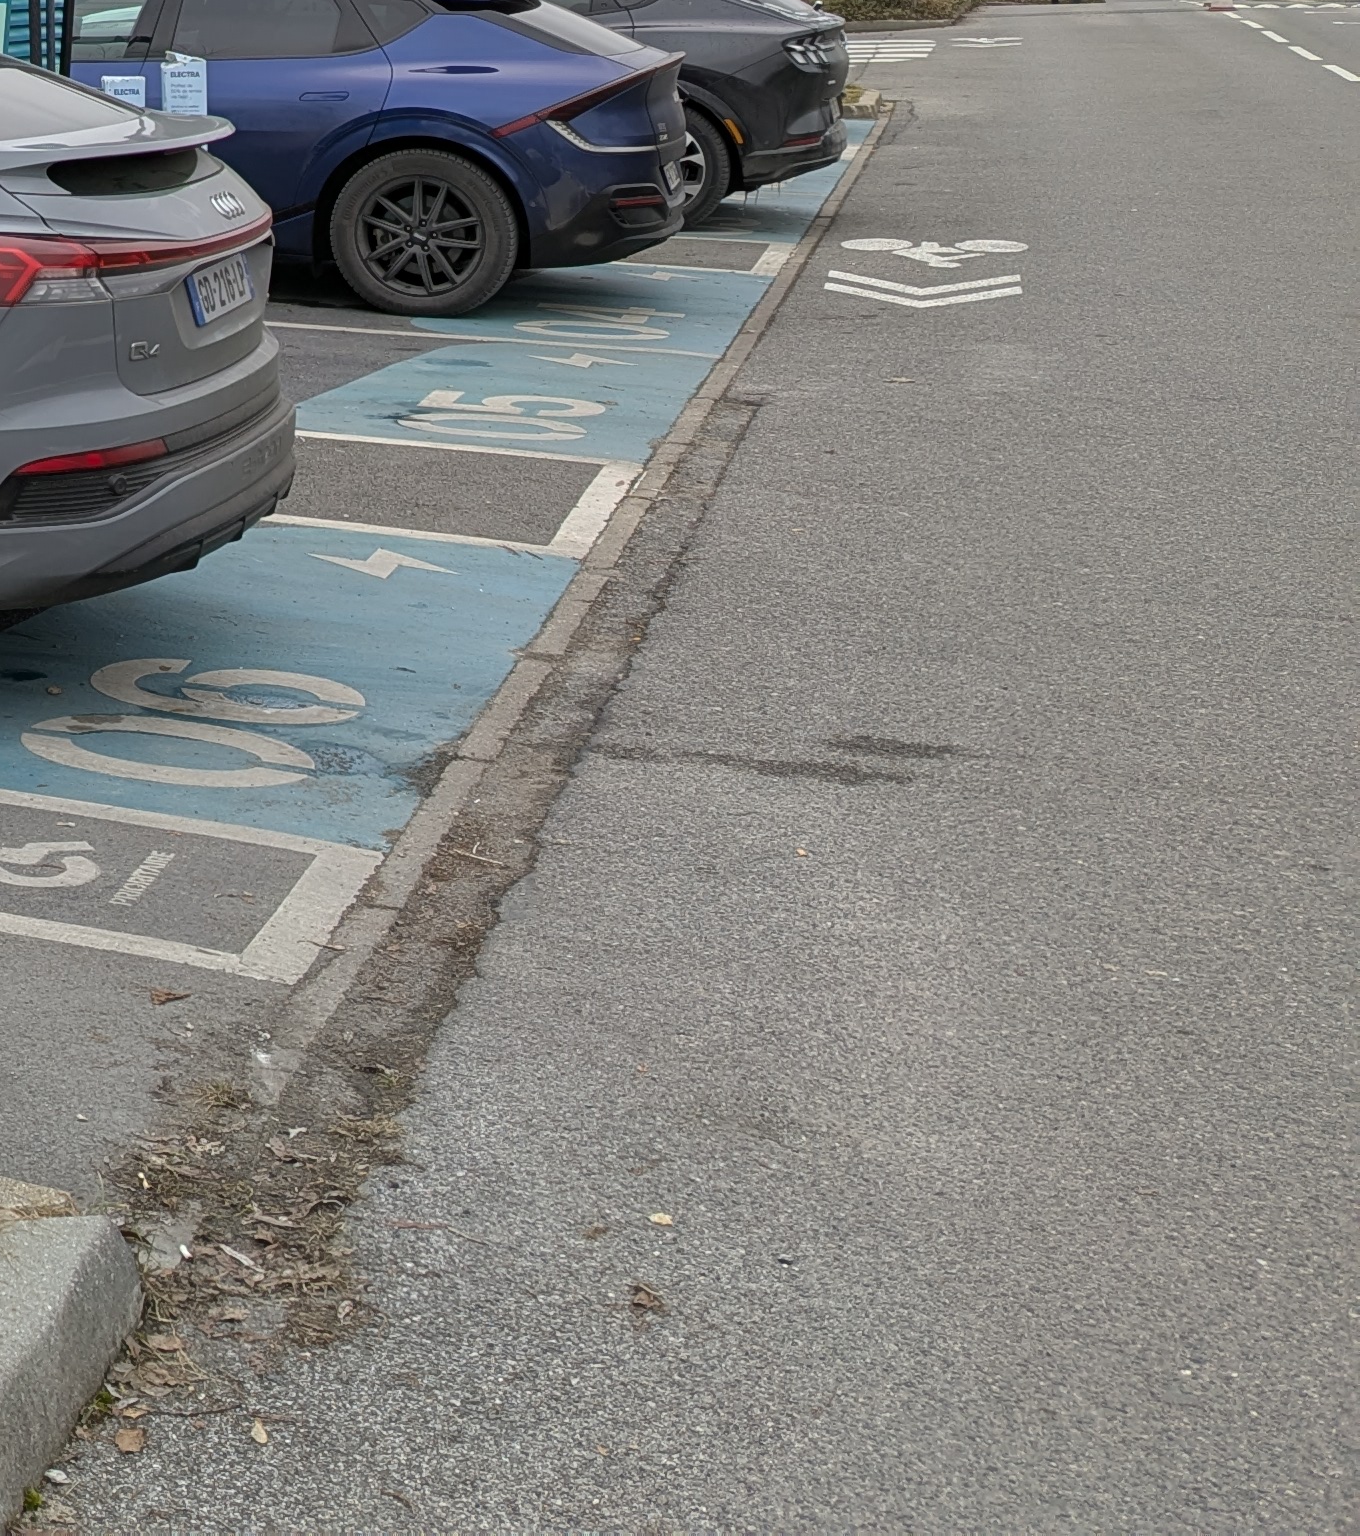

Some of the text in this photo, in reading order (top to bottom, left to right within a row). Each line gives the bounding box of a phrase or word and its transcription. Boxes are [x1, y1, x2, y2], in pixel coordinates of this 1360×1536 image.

[113, 88, 140, 96] ELECTRA
[197, 261, 246, 314] GD-216-LP
[514, 302, 686, 341] 04
[129, 340, 160, 361] Q4
[395, 389, 606, 441] 05
[21, 658, 366, 788] 06
[108, 850, 175, 906] PRIORITAIRE
